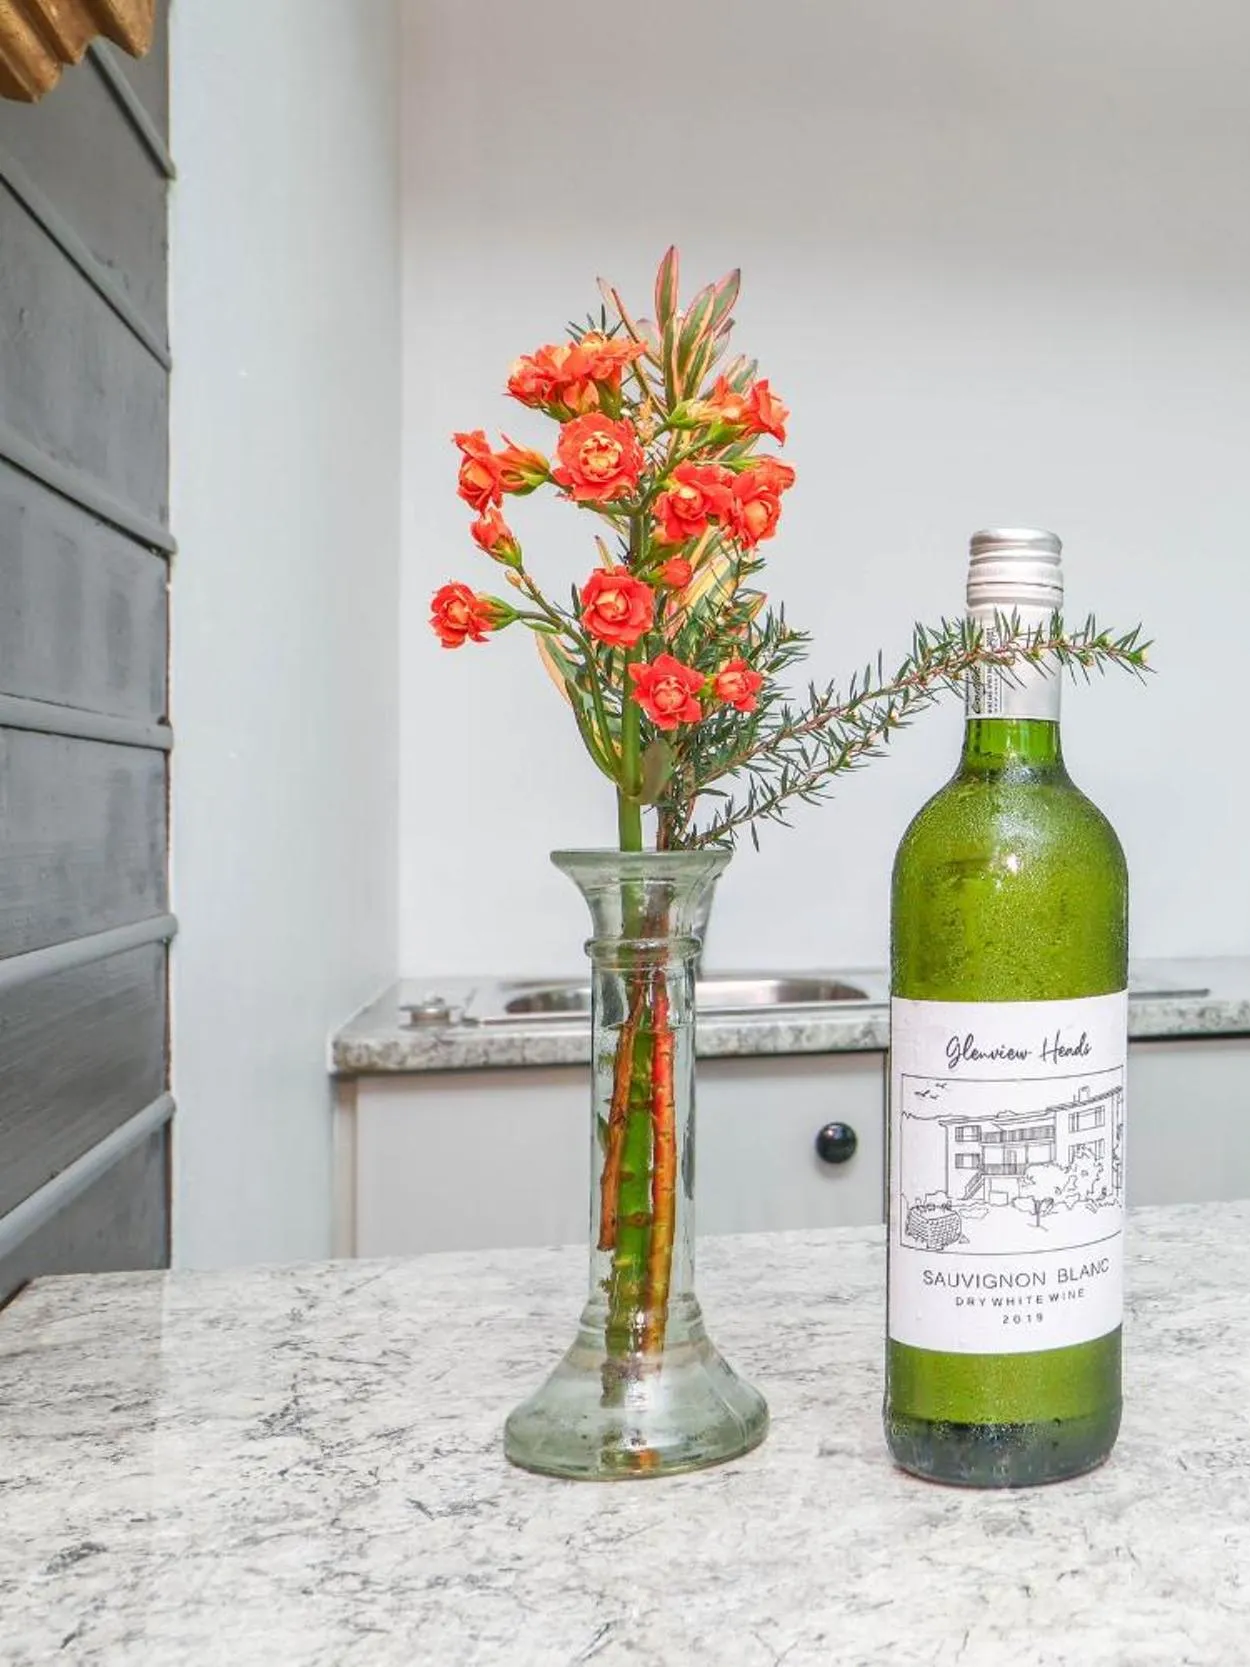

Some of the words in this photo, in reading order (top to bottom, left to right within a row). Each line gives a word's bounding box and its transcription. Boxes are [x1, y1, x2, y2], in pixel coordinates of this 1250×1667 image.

[946, 1033, 1032, 1069] Glenview
[922, 1269, 1047, 1290] SAUVIGNON
[1057, 1257, 1110, 1283] BLANC
[955, 1296, 986, 1307] DRY
[992, 1295, 1044, 1307] WHITE
[1049, 1288, 1085, 1303] WINE
[1003, 1313, 1044, 1325] 2019
